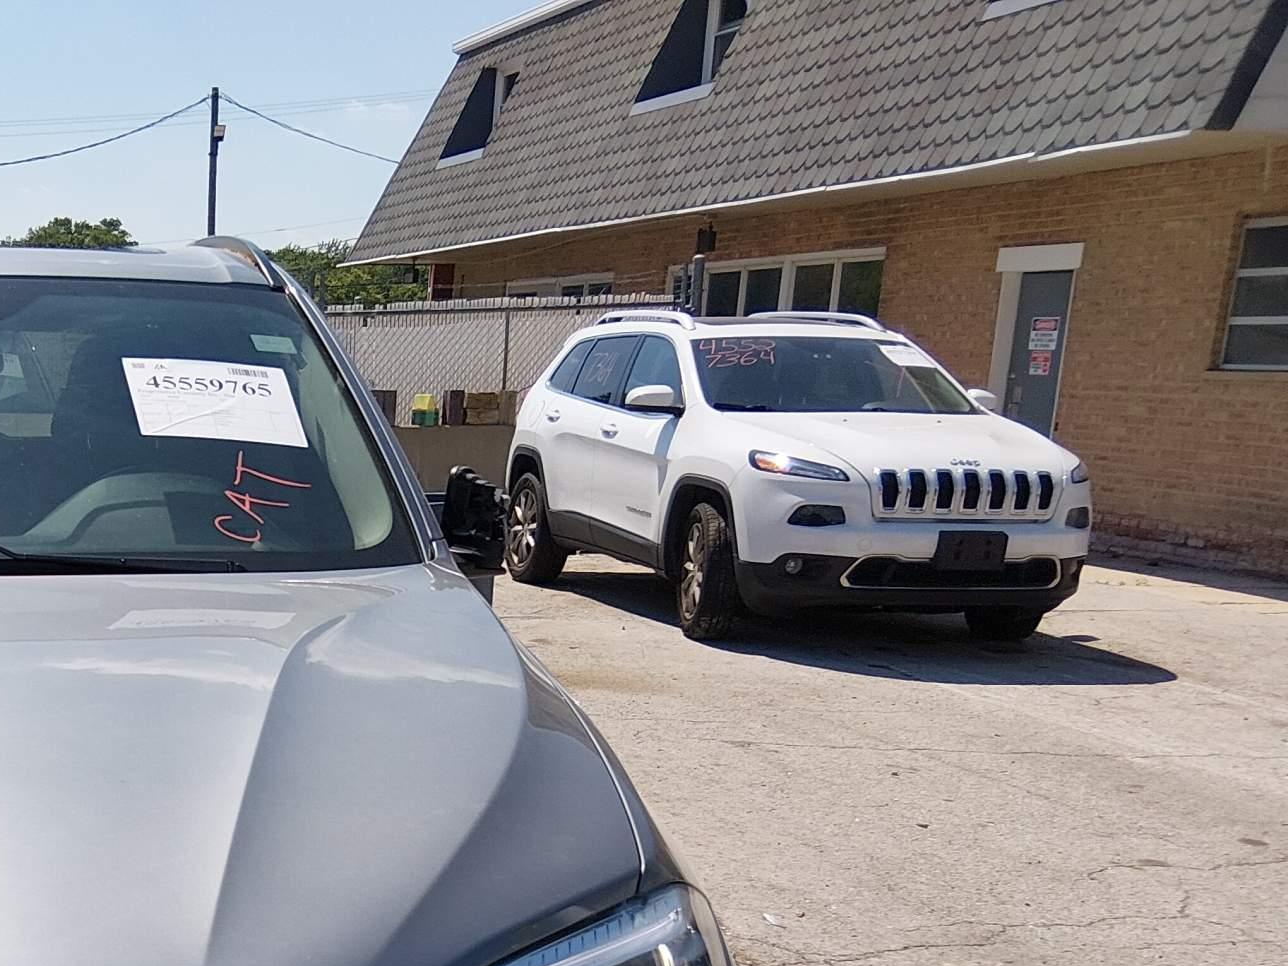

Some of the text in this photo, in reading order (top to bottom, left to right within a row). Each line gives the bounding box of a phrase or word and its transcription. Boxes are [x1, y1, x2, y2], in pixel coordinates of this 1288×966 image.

[698, 339, 776, 355] 4552
[705, 350, 775, 368] 7364
[145, 375, 273, 398] 45559765
[214, 450, 312, 542] CAT
